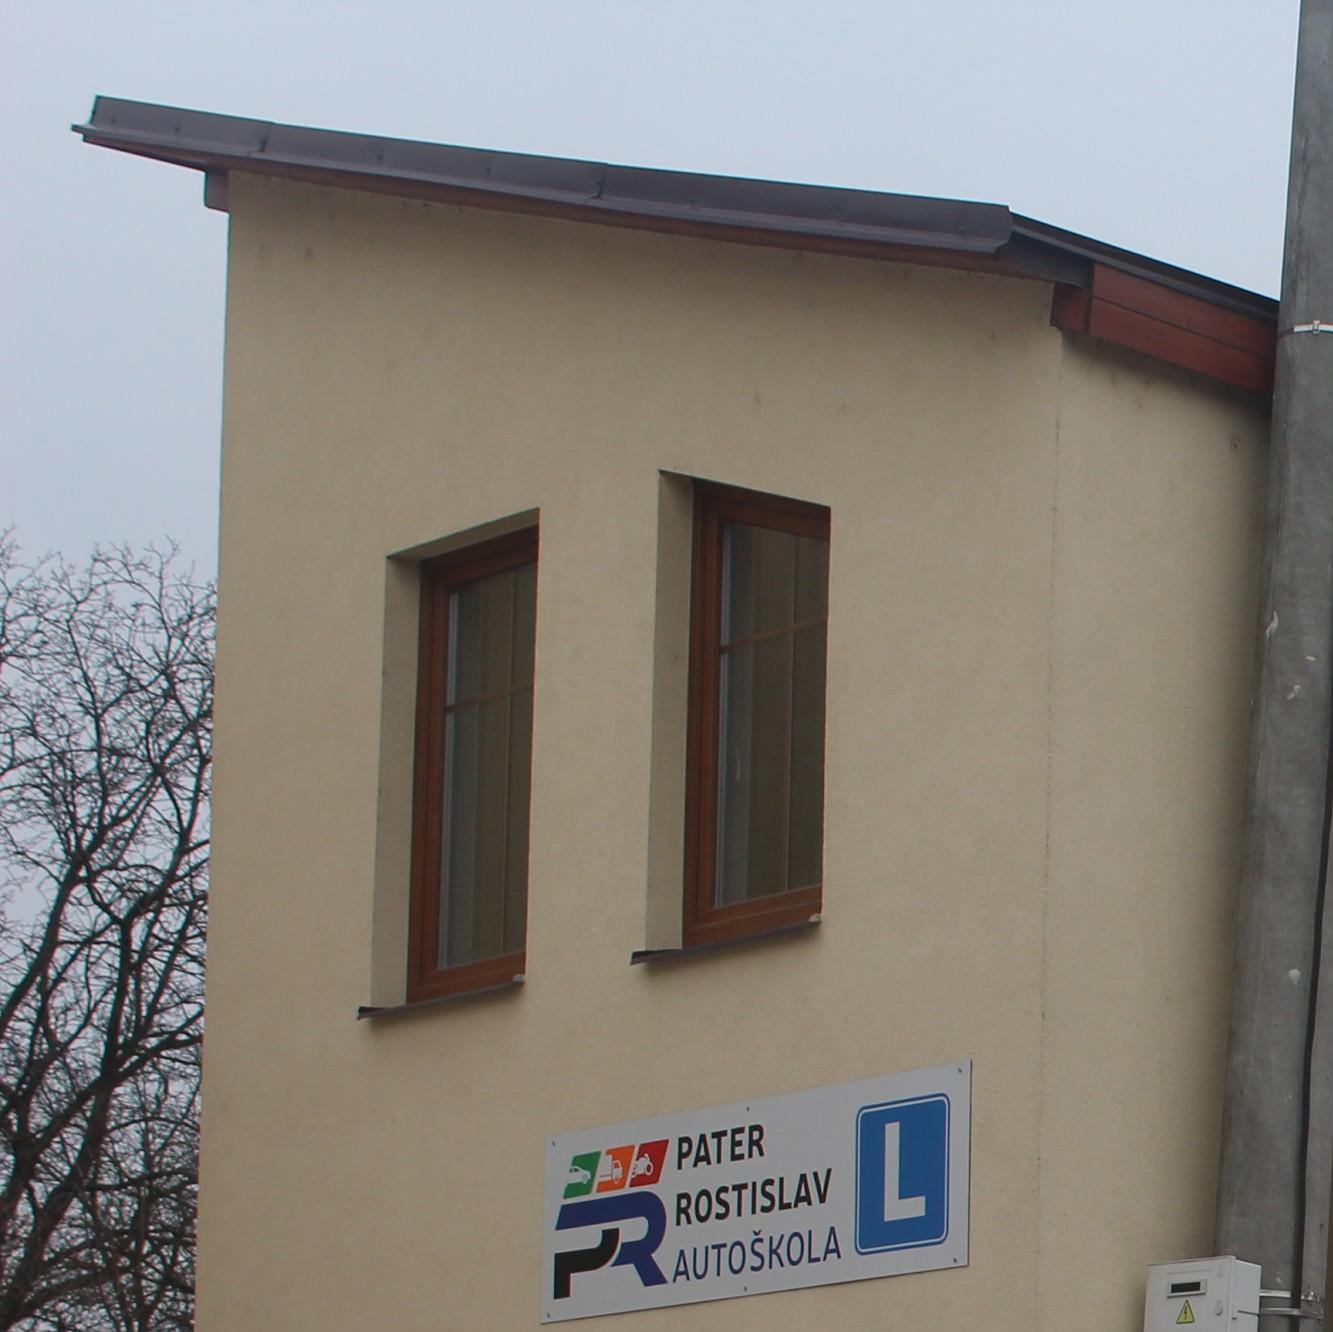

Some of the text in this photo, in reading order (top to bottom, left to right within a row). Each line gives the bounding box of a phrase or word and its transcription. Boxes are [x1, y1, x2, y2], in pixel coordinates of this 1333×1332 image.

[677, 1124, 765, 1171] PATER
[884, 1121, 926, 1222] L
[675, 1168, 832, 1227] ROSTISLAV
[672, 1226, 842, 1284] AUTOŠKOLA
